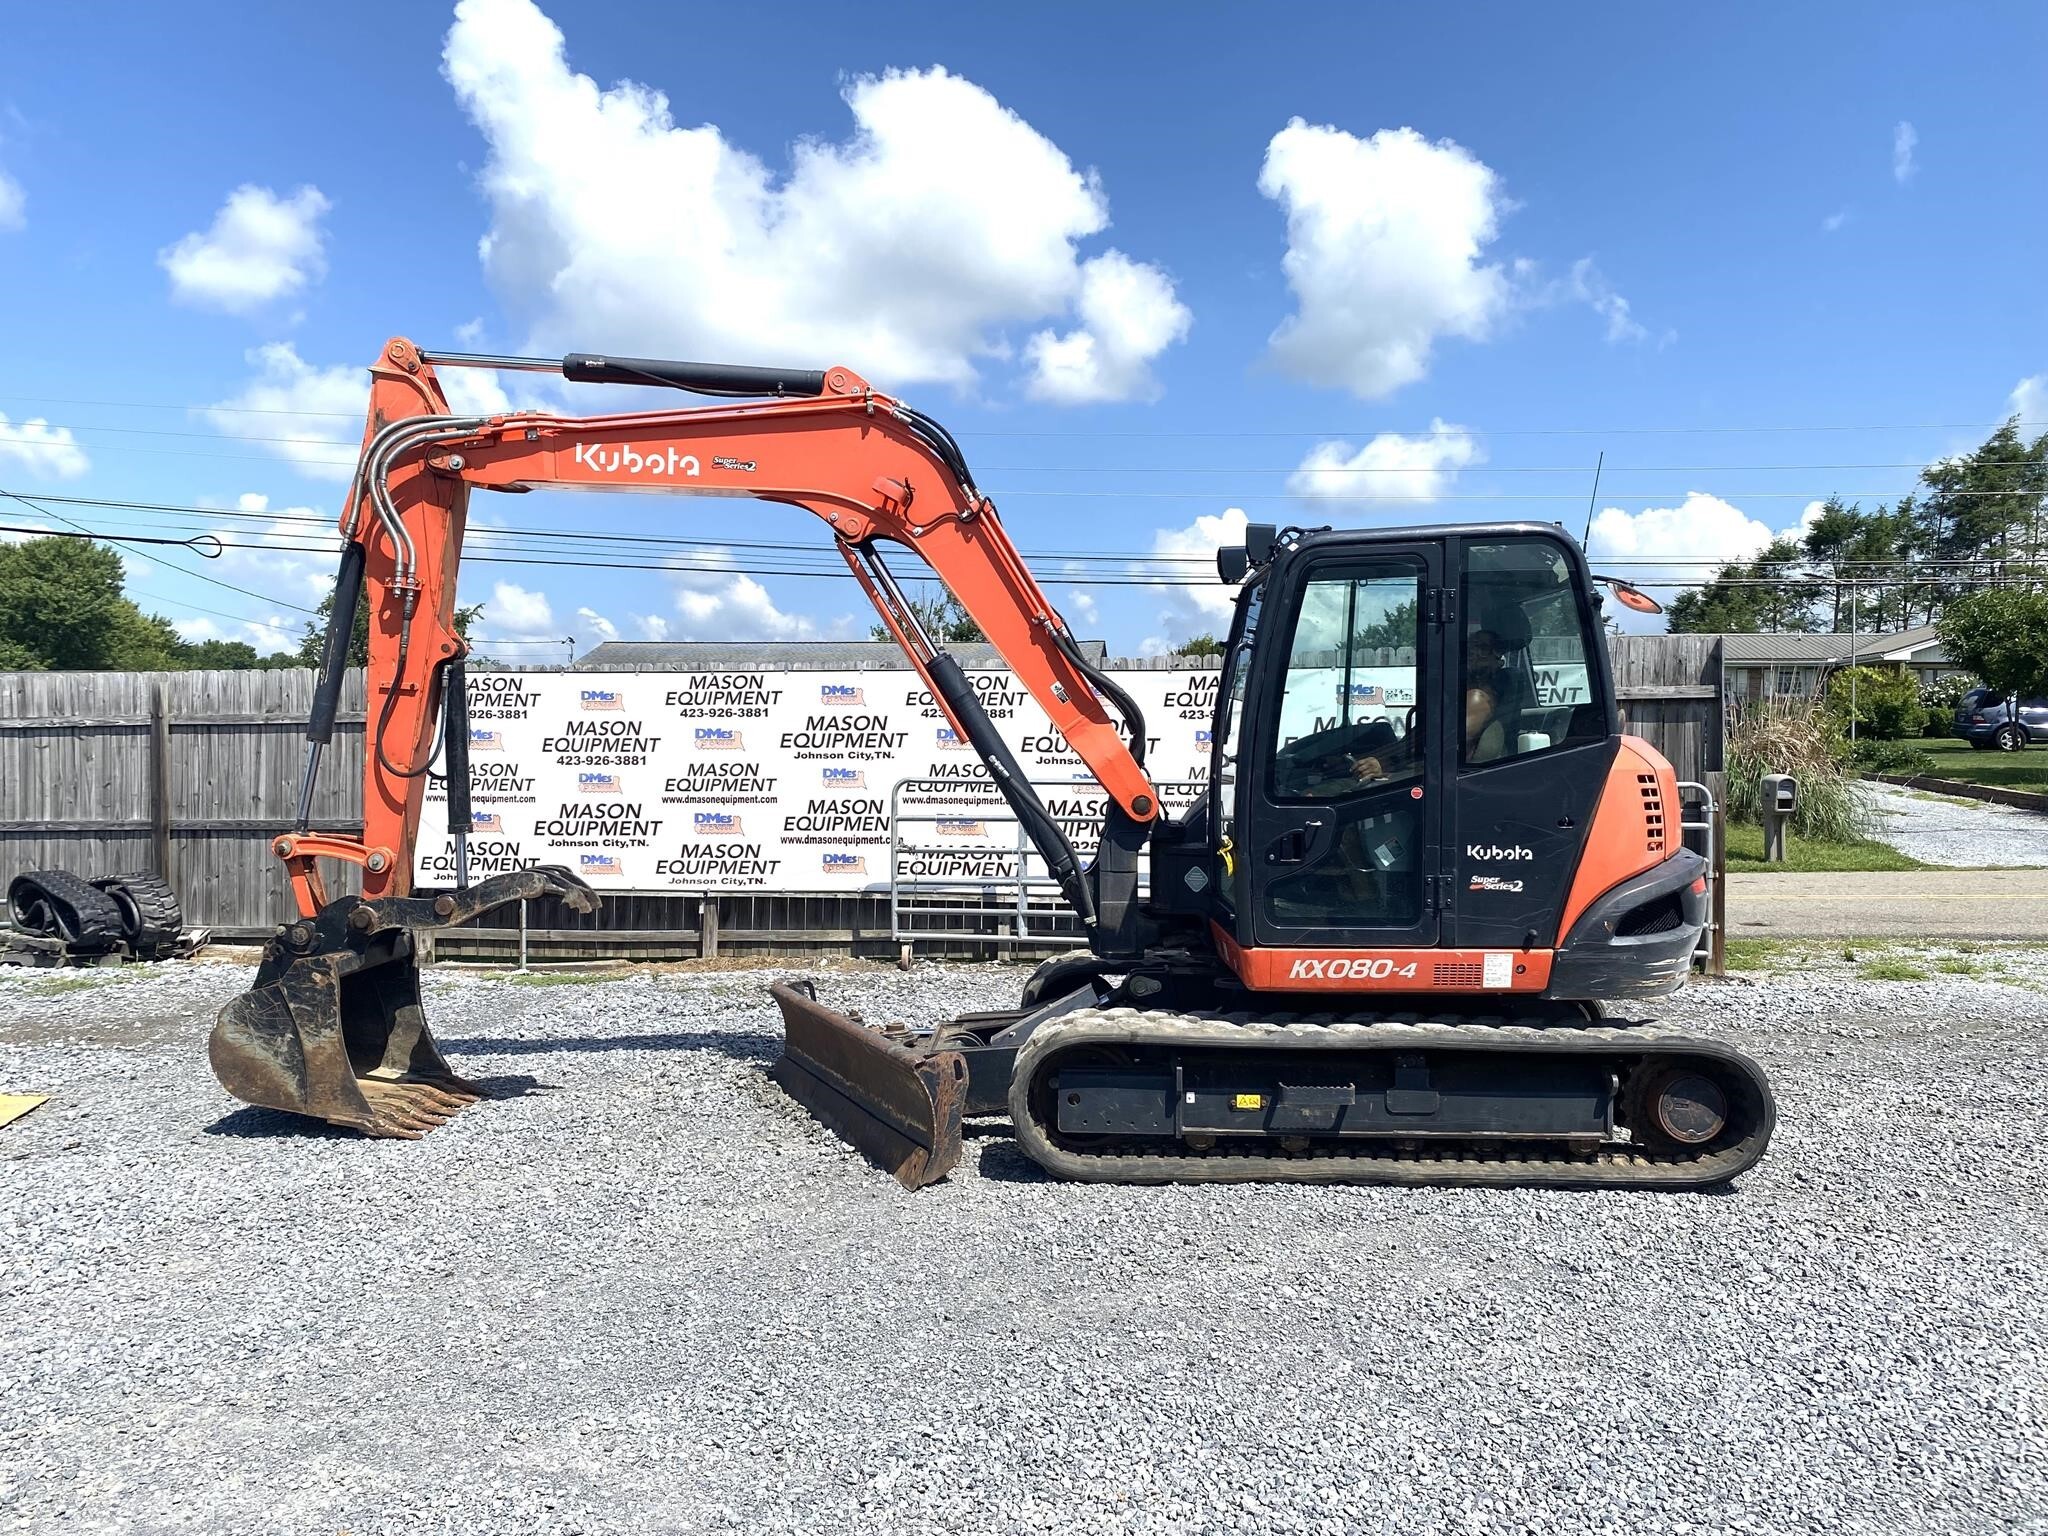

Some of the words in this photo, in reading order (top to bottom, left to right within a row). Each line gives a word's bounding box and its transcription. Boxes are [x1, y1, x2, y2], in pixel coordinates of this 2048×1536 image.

[575, 442, 700, 476] Kubota
[713, 456, 738, 465] Super
[469, 677, 523, 692] ASON
[689, 675, 764, 690] MASON
[967, 676, 1009, 690] SON
[468, 693, 541, 707] IPMENT
[665, 691, 783, 705] EQUIPMENT
[469, 710, 528, 719] 926-3881
[680, 708, 769, 717] 423-926-3881
[566, 720, 642, 736] MASON
[806, 715, 888, 731] MASON
[542, 738, 661, 752] EQUIPMENT
[780, 733, 909, 748] EQUIPMENT
[556, 755, 646, 765] 423-926-3881
[1036, 757, 1085, 765] Johnso
[469, 763, 519, 777] ASON
[687, 763, 759, 777] MASON
[929, 764, 991, 777] MASO
[665, 778, 777, 792] EQUIPMENT
[906, 781, 999, 793] EQUIPME
[426, 794, 536, 805] www.nequipment.com
[661, 795, 778, 806] www.dmasonequipment.com
[559, 803, 642, 819] MASON
[807, 799, 884, 815] MASON
[534, 821, 663, 836] EQUIPMENT
[784, 816, 890, 831] EQUIPMEN
[548, 839, 599, 847] Johnson
[681, 844, 761, 859] MASON
[1466, 844, 1533, 860] Kubota
[656, 860, 781, 874] EQUIPMENT
[1471, 875, 1501, 885] Super
[1288, 958, 1418, 979] KX080-4
